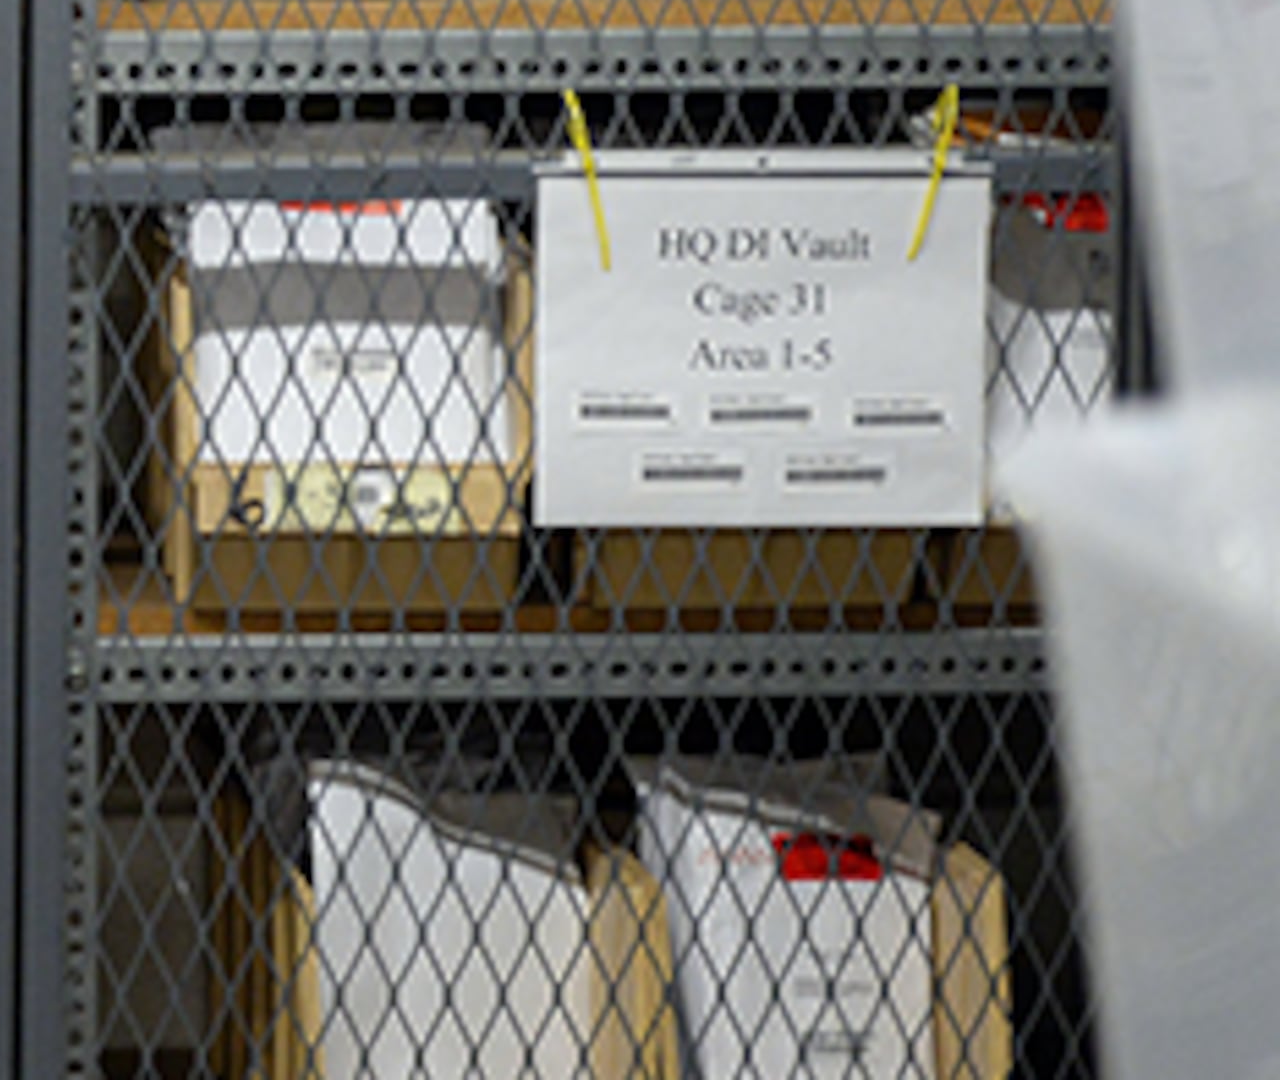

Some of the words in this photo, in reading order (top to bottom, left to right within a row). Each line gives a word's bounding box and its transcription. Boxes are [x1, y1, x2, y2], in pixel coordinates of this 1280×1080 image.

[658, 227, 719, 266] HQ
[726, 227, 770, 260] DI
[781, 228, 871, 261] Vault
[692, 282, 780, 325] Cage
[788, 282, 826, 315] 31
[689, 339, 770, 372] Area
[782, 338, 833, 371] 1-5
